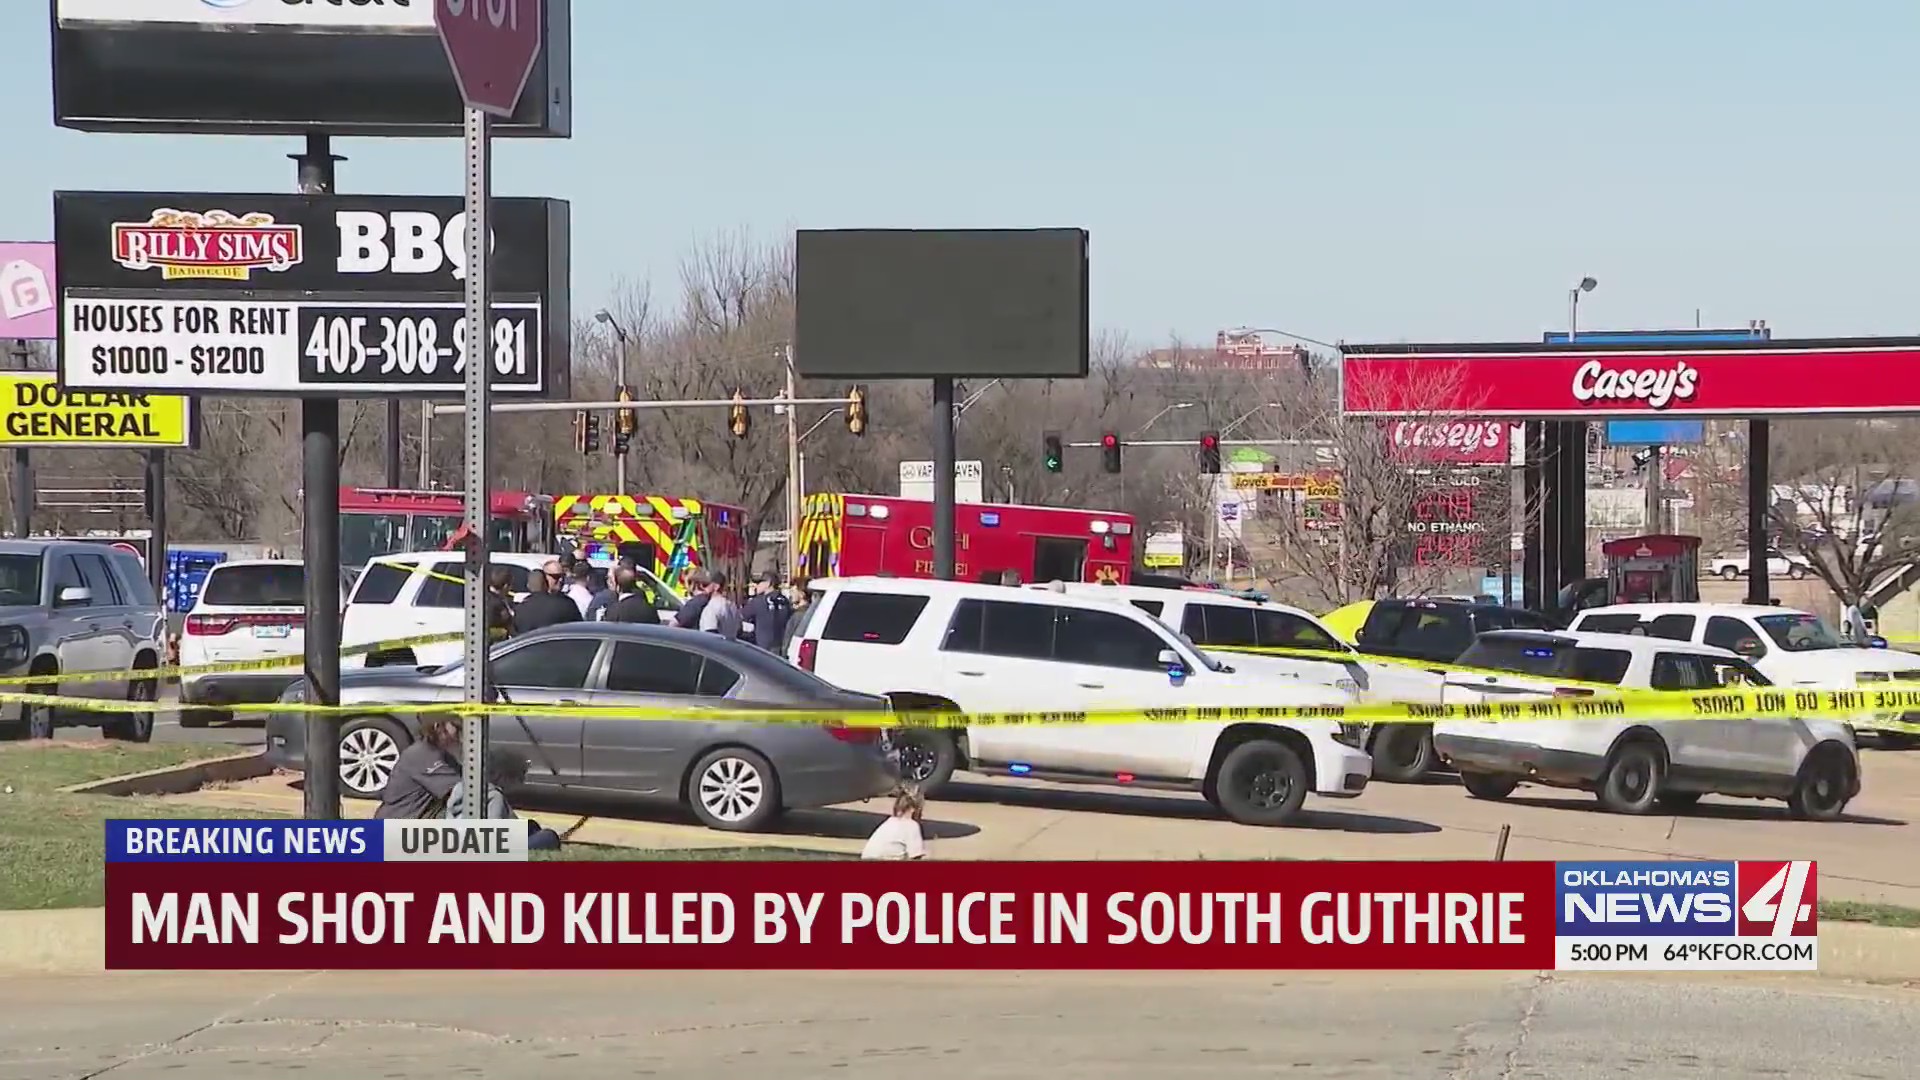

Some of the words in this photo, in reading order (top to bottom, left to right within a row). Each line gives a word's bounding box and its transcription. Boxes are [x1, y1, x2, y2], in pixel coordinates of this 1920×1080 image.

[126, 231, 212, 265] BILLY
[218, 232, 289, 265] SIMS
[73, 304, 164, 333] HOUSES
[173, 306, 219, 335] FOR
[229, 307, 291, 336] RENT
[305, 316, 526, 375] 405-308-981
[91, 345, 169, 377] $1000
[190, 345, 266, 377] $1200
[1571, 359, 1699, 408] Casey's
[6, 411, 161, 438] GENERAL
[1393, 420, 1502, 455] Casey's
[1407, 522, 1426, 533] NO
[1692, 695, 1745, 715] CROSS
[1757, 694, 1786, 713] NOT
[1797, 694, 1818, 711] DO
[1828, 691, 1866, 710] LINE
